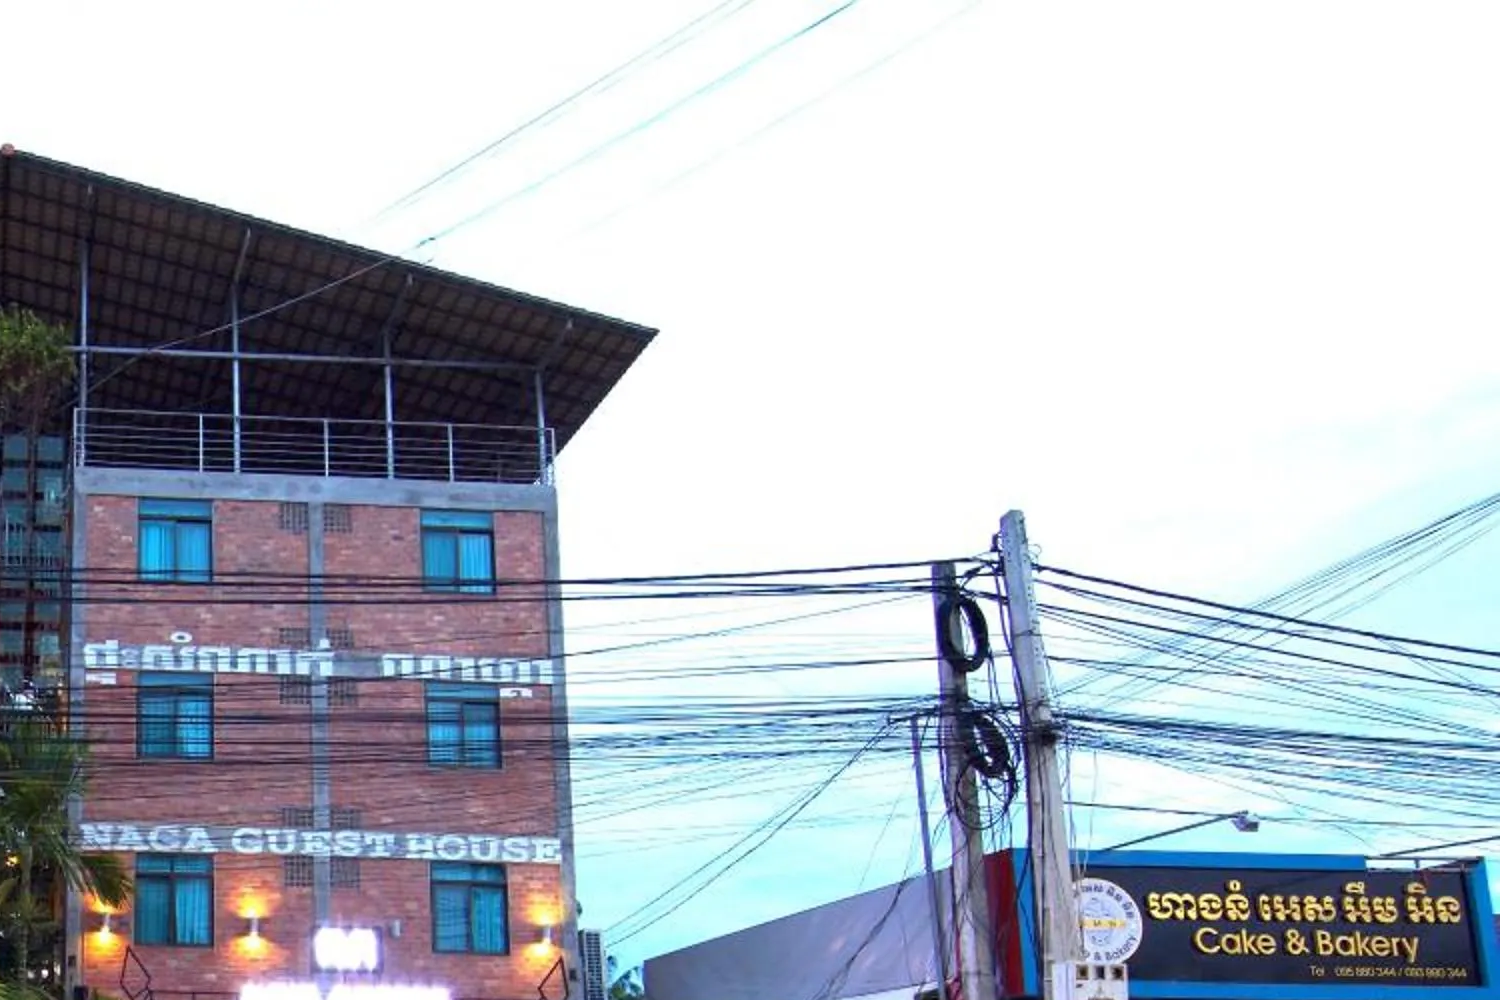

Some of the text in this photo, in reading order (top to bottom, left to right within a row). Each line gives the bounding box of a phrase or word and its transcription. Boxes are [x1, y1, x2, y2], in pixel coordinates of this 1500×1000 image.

[79, 823, 562, 863] NAGA GUEST HOUSE
[1194, 927, 1419, 964] Cake & Bakery
